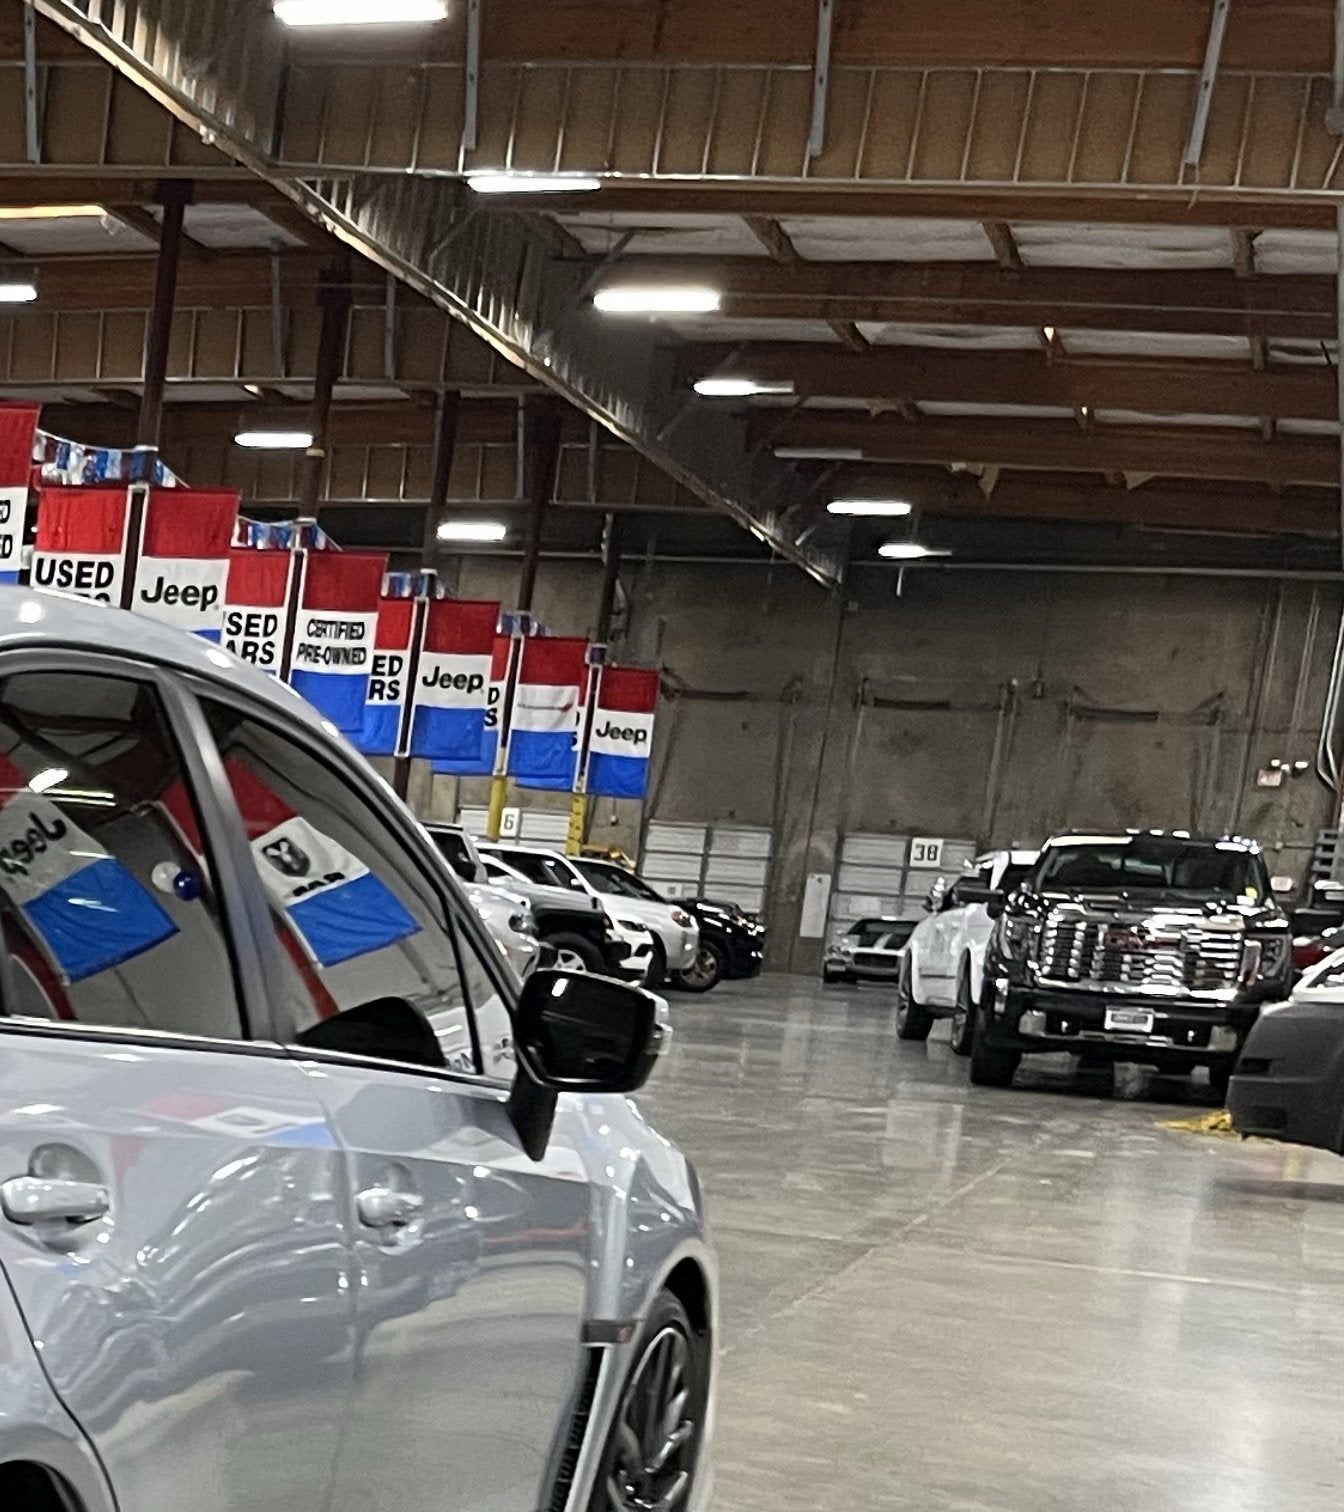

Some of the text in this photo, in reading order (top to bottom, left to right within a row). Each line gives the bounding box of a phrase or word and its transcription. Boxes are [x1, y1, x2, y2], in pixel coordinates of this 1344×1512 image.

[35, 558, 115, 588] USED
[141, 576, 219, 612] Jeep
[223, 611, 278, 638] SED
[307, 619, 365, 640] CERTIFIED
[226, 640, 276, 664] ARS
[296, 643, 367, 665] PRE-OWNED
[372, 655, 404, 676] ED
[369, 679, 401, 700] RS
[422, 666, 484, 694] Jeep
[596, 721, 648, 745] Jeep
[504, 814, 515, 830] 6
[913, 844, 938, 861] 38
